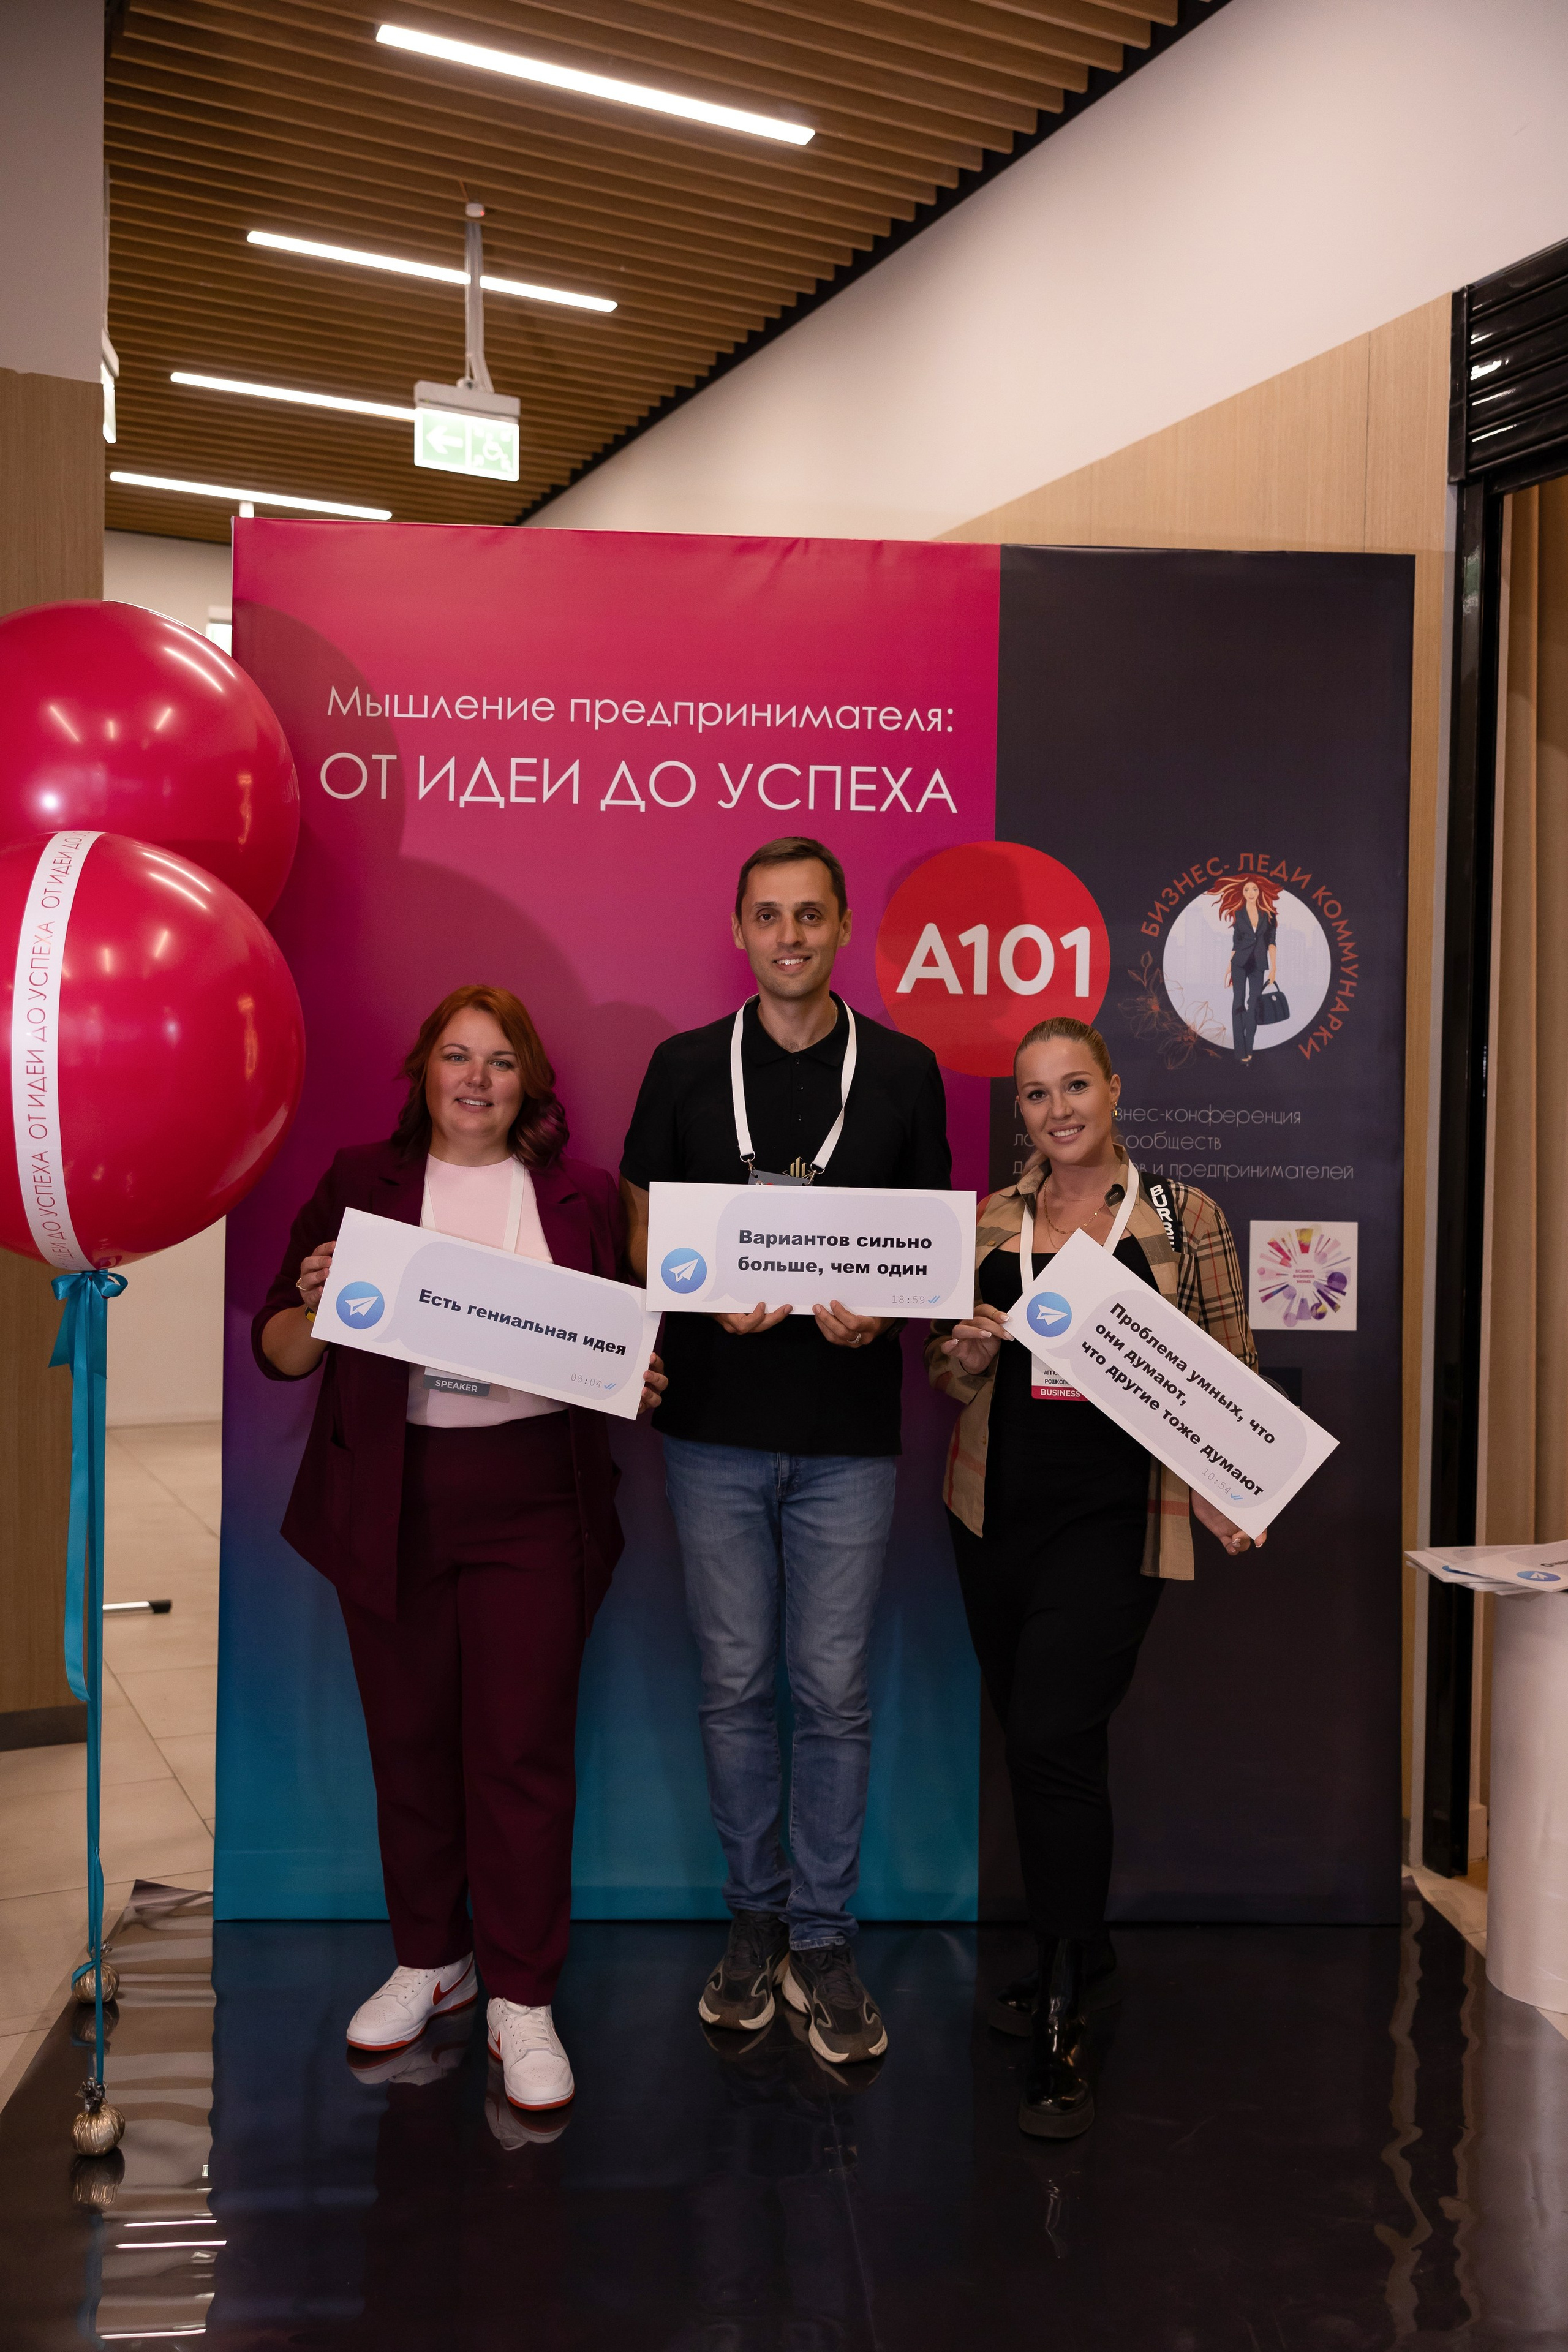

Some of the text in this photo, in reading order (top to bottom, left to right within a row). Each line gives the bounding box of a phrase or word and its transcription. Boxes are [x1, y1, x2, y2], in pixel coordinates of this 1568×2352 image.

[327, 685, 954, 733] Мышление предпринимателя:
[320, 752, 958, 814] ОТ ИДЕИ ДО УСПЕХА
[47, 851, 75, 884] ИДЕИ
[41, 888, 62, 909] ОТ
[1238, 853, 1312, 889] ЛЕДИ
[1298, 885, 1359, 1060] КОММУНАРКИ
[26, 921, 55, 1139] ОТ ИДЕИ ДО УСПЕХА
[31, 1150, 58, 1217] УСПЕХА
[1169, 1163, 1354, 1182] предпринимателей
[42, 1221, 67, 1240] ДО
[739, 1229, 932, 1250] Вариантов сильно
[737, 1256, 927, 1278] больше, чем один
[892, 1295, 925, 1304] 18:59
[418, 1288, 627, 1356] Есть гениальная идея
[1095, 1324, 1186, 1406] они думают,
[1109, 1302, 1275, 1444] Проблема умных, что
[435, 1379, 478, 1392] SPEAKER
[571, 1373, 601, 1389] 08:04
[1041, 1389, 1080, 1397] BUSINESS
[1082, 1341, 1264, 1496] что другие тоже думают
[1201, 1468, 1231, 1494] 10:54
